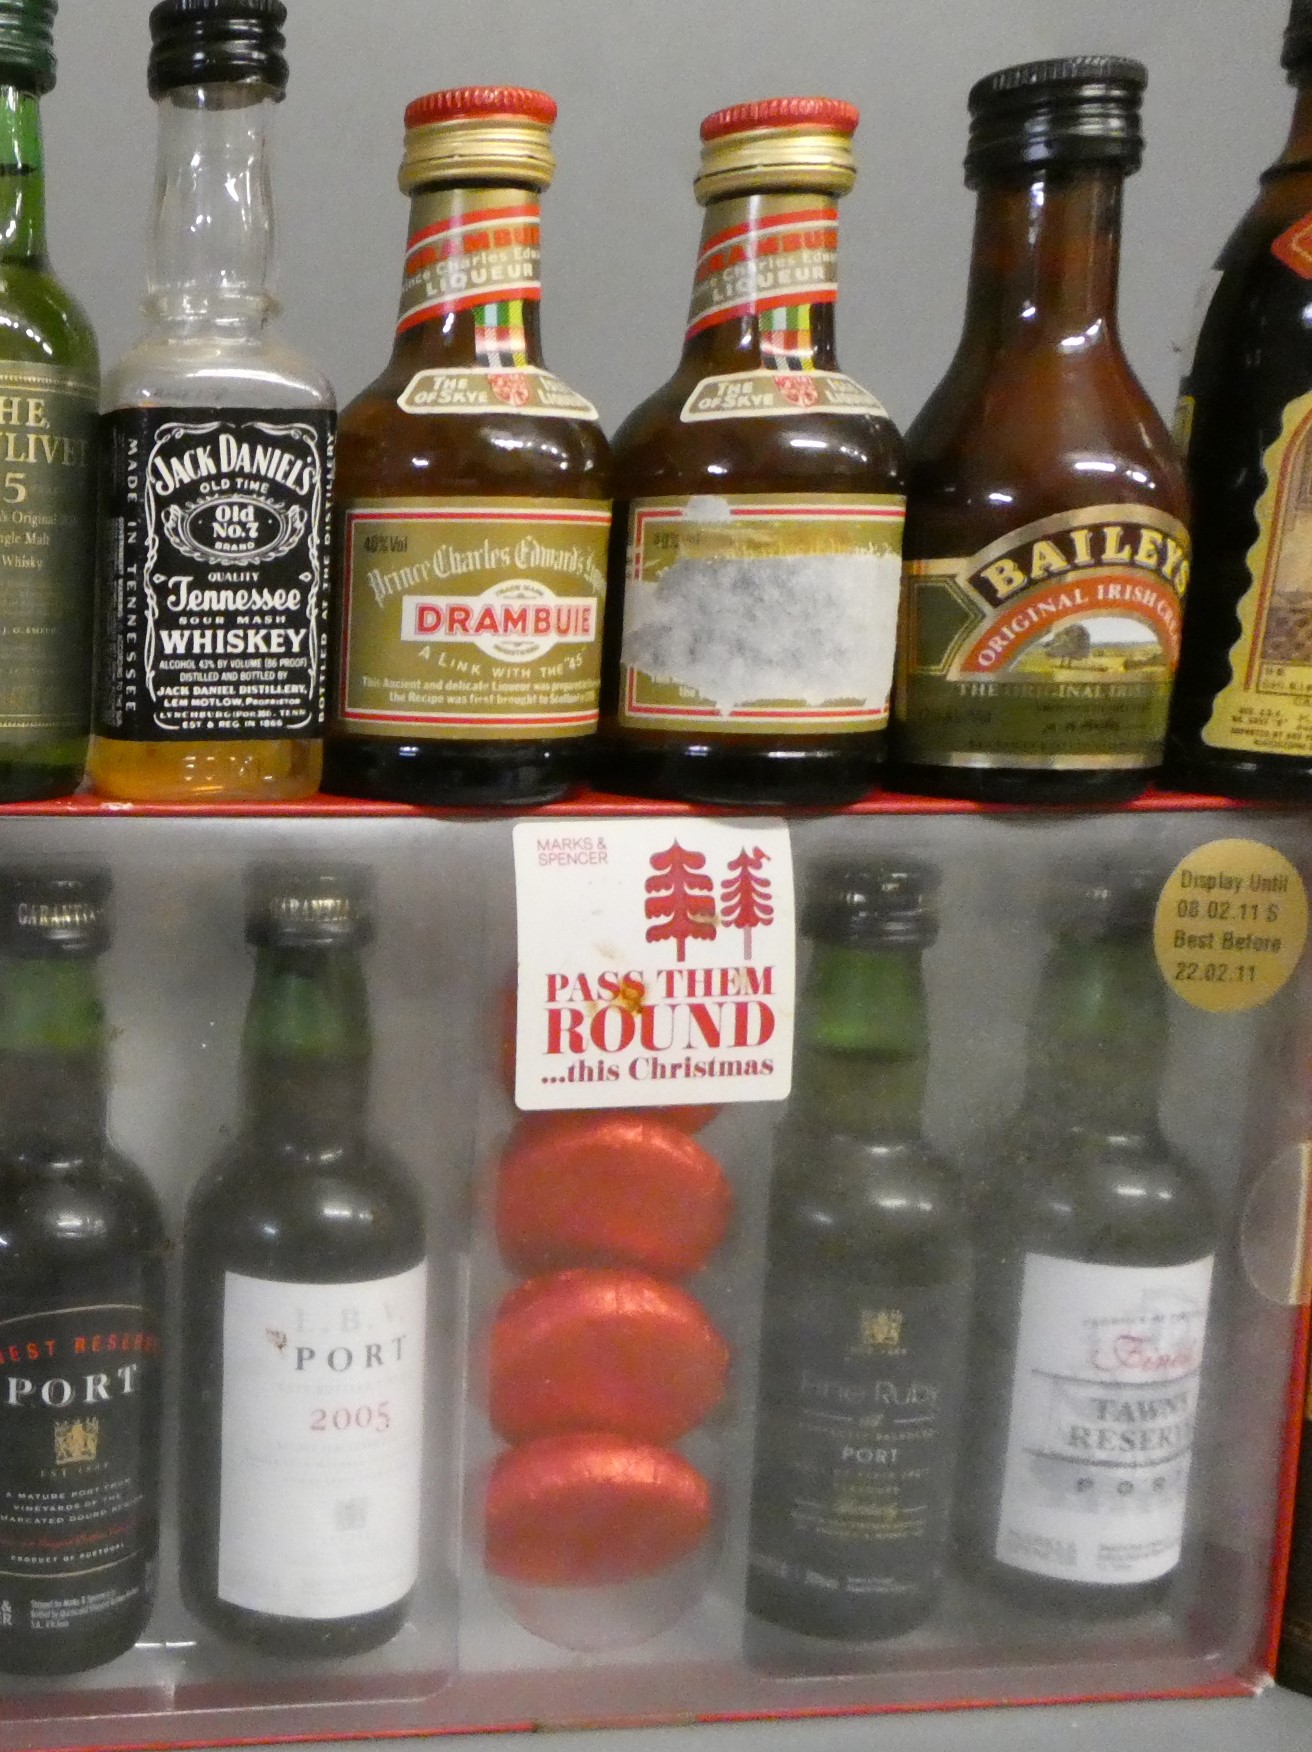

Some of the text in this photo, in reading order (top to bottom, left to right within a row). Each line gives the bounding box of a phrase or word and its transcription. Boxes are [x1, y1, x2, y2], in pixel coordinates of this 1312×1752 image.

[426, 262, 533, 297] LIQUEUR
[712, 265, 824, 303] LIQUEUR
[433, 376, 468, 390] THE
[717, 382, 753, 396] THE
[154, 445, 217, 496] JACK
[219, 433, 317, 496] DANIEL'S
[199, 477, 270, 494] OLD TIME
[215, 505, 255, 523] Old
[25, 530, 50, 546] Malt
[212, 521, 259, 539] No.7
[214, 541, 255, 551] BRAND
[1, 554, 43, 571] Whisky
[433, 539, 511, 578] Charles
[981, 526, 1189, 600] BAILEYS
[125, 438, 139, 712] MADE IN TENNESSEE
[207, 571, 260, 582] QUALITY
[166, 575, 301, 612] Tennessee
[178, 615, 287, 625] SOUR MASH
[415, 603, 592, 635] DRAMBUIE
[978, 583, 1157, 667] ORIGINAL IRISH
[159, 628, 308, 654] WHISKEY
[159, 660, 196, 669] ALCOHOL
[198, 659, 215, 669] 43%
[217, 659, 228, 669] BY
[230, 658, 263, 669] VOLUME
[279, 658, 308, 668] PROOF)
[419, 645, 564, 678] A LINK WITH THE
[179, 670, 288, 682] DISTILLED AND BOTTLED BY
[423, 679, 443, 690] and
[157, 686, 190, 697] JACK
[192, 685, 236, 695] DANIEL
[447, 694, 467, 704] was
[164, 698, 188, 708] LEM
[537, 837, 607, 851] MARKS &
[538, 852, 608, 866] SPENCER
[1180, 869, 1288, 893] Display Until
[1174, 929, 1282, 953] Best Before
[545, 965, 776, 1003] PASS THEM
[544, 1000, 776, 1056] ROUND
[628, 1055, 775, 1082] Christmas
[295, 1334, 408, 1372] PORT
[8, 1363, 138, 1407] PORT
[310, 1401, 392, 1434] 2005
[842, 1445, 898, 1464] PORT
[18, 1492, 65, 1501] MATURE
